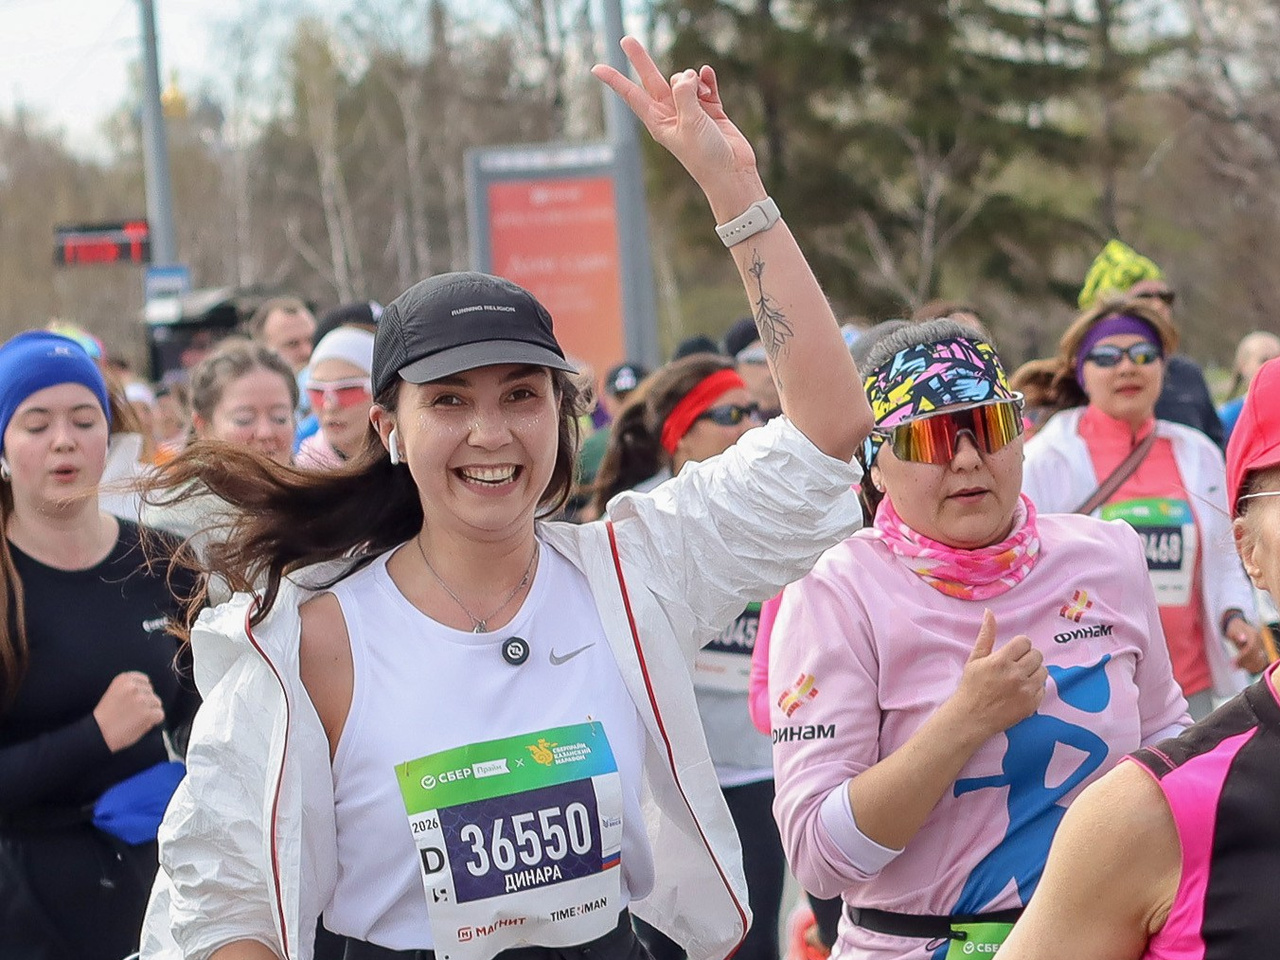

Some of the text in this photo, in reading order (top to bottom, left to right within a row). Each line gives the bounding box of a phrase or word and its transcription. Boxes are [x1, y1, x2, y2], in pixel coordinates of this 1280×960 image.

[451, 304, 516, 317] RUNNING RELIGION
[437, 763, 502, 784] СБЕР Прайм
[412, 817, 439, 834] 2026
[460, 802, 593, 877] 36550
[420, 847, 446, 876] D
[505, 864, 563, 893] ДИНАРА
[976, 943, 1001, 953] СБЕ
